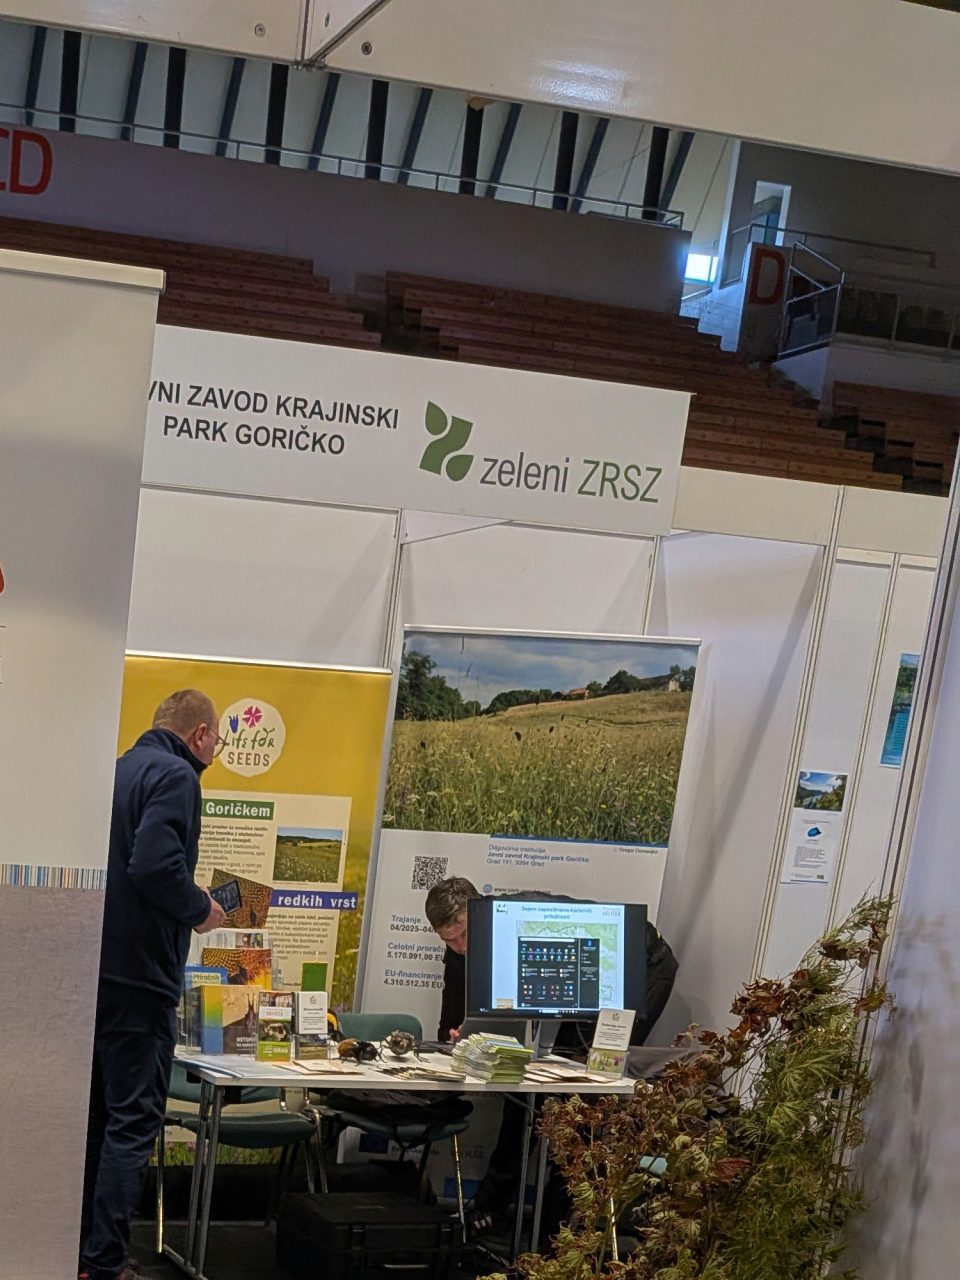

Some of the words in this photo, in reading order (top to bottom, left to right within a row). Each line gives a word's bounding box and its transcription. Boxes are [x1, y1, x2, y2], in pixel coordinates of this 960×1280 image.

[187, 385, 268, 413] ZAVOD
[276, 395, 399, 429] KRAJINSKI
[163, 415, 228, 442] PARK
[236, 425, 345, 455] GORIČKO
[480, 452, 570, 493] zeleni
[578, 459, 662, 503] ZRSZ
[227, 752, 270, 767] SEEDS
[206, 802, 270, 817] Goričkem
[278, 894, 323, 907] redkih
[331, 896, 356, 908] vrst
[391, 914, 421, 925] Trajanje
[388, 942, 414, 952] Celotni
[386, 952, 432, 961] 5.170.991,00
[384, 979, 429, 989] 4.310.512,35
